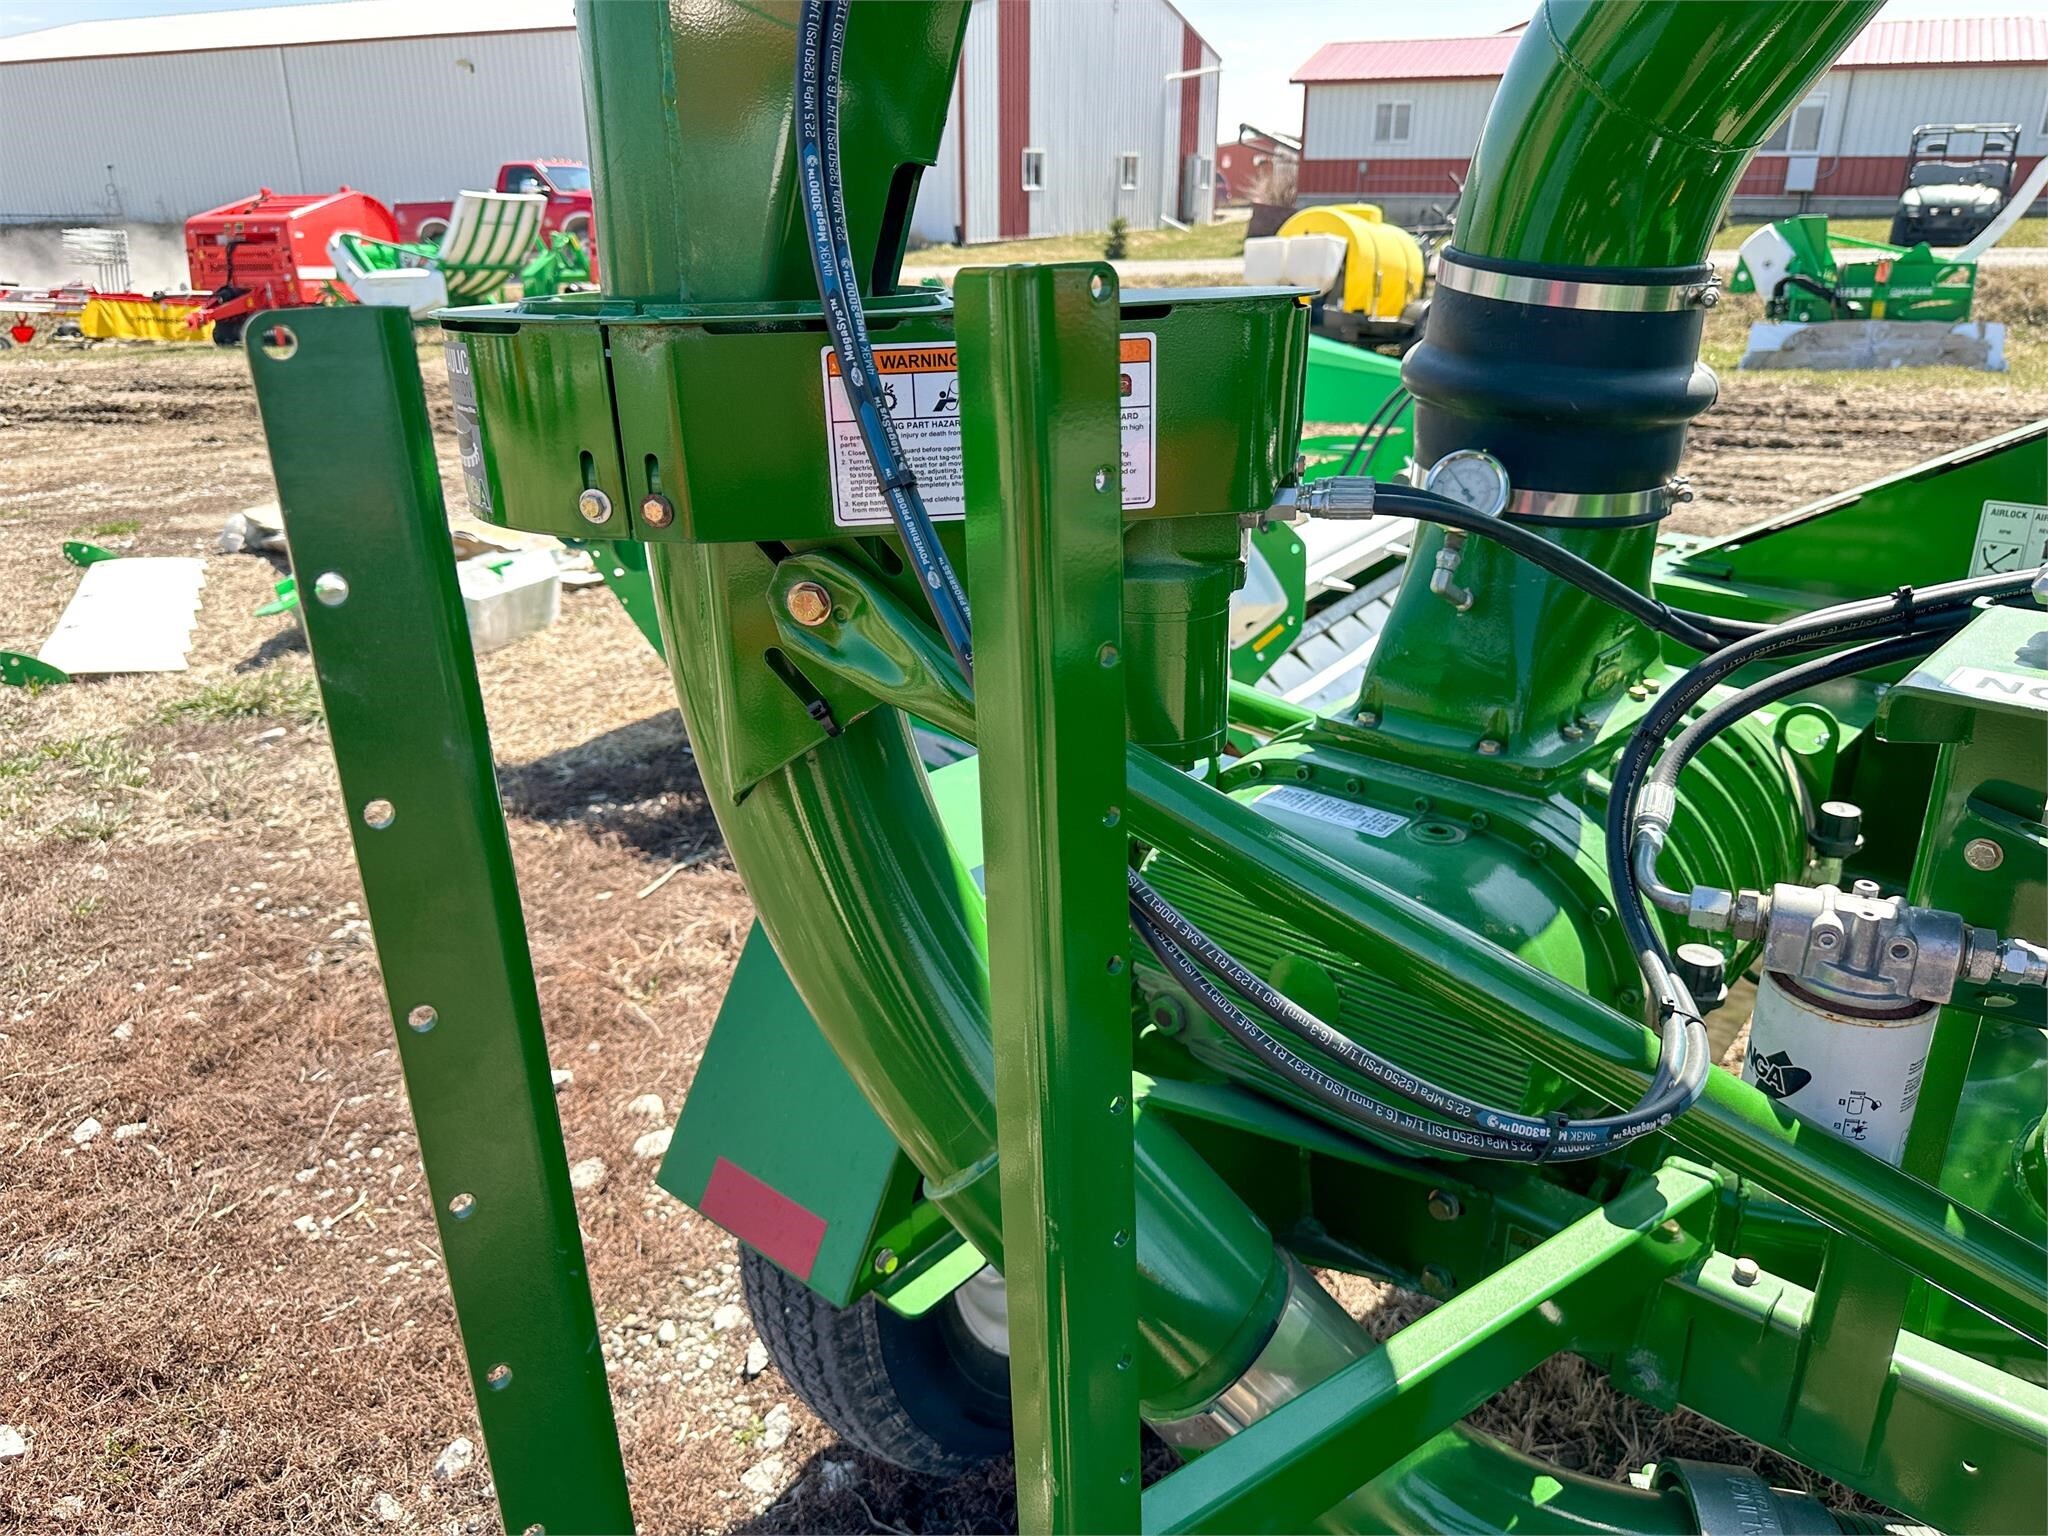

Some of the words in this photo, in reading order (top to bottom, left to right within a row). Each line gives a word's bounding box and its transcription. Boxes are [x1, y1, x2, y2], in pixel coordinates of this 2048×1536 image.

[832, 23, 843, 43] ISO
[804, 48, 817, 83] (3250
[804, 86, 814, 110] MPa
[805, 113, 816, 138] 22.5
[808, 168, 829, 242] Mega3000™
[832, 190, 842, 214] MPa
[835, 217, 846, 241] 22.5
[820, 245, 833, 277] 4M3K
[862, 346, 875, 375] 4M3K
[931, 420, 961, 429] HAZAR
[1129, 423, 1144, 431] high
[935, 495, 959, 504] clothing
[1991, 508, 2027, 519] AIRLOCK
[906, 522, 931, 566] POWERING
[1143, 892, 1181, 929] 100R17
[1180, 924, 1202, 946] SAE
[1178, 950, 1198, 977] ISO
[1206, 945, 1229, 968] R17
[1228, 965, 1262, 993] 11237
[1200, 976, 1238, 1017] 100R17
[1262, 990, 1283, 1009] ISO
[1236, 1014, 1257, 1037] SAE
[1281, 1004, 1308, 1026] mm)
[1309, 1024, 1333, 1045] (6.3
[1265, 1038, 1287, 1060] R17
[1287, 1057, 1322, 1084] 11237
[1384, 1069, 1418, 1094] (3250
[1324, 1078, 1346, 1097] ISO
[1420, 1087, 1446, 1107] MPa
[1444, 1099, 1472, 1118] 22.5
[1485, 1138, 1508, 1150] MPa
[1499, 1123, 1568, 1142] Mga3000™
[1570, 1130, 1597, 1142] 4M3K
